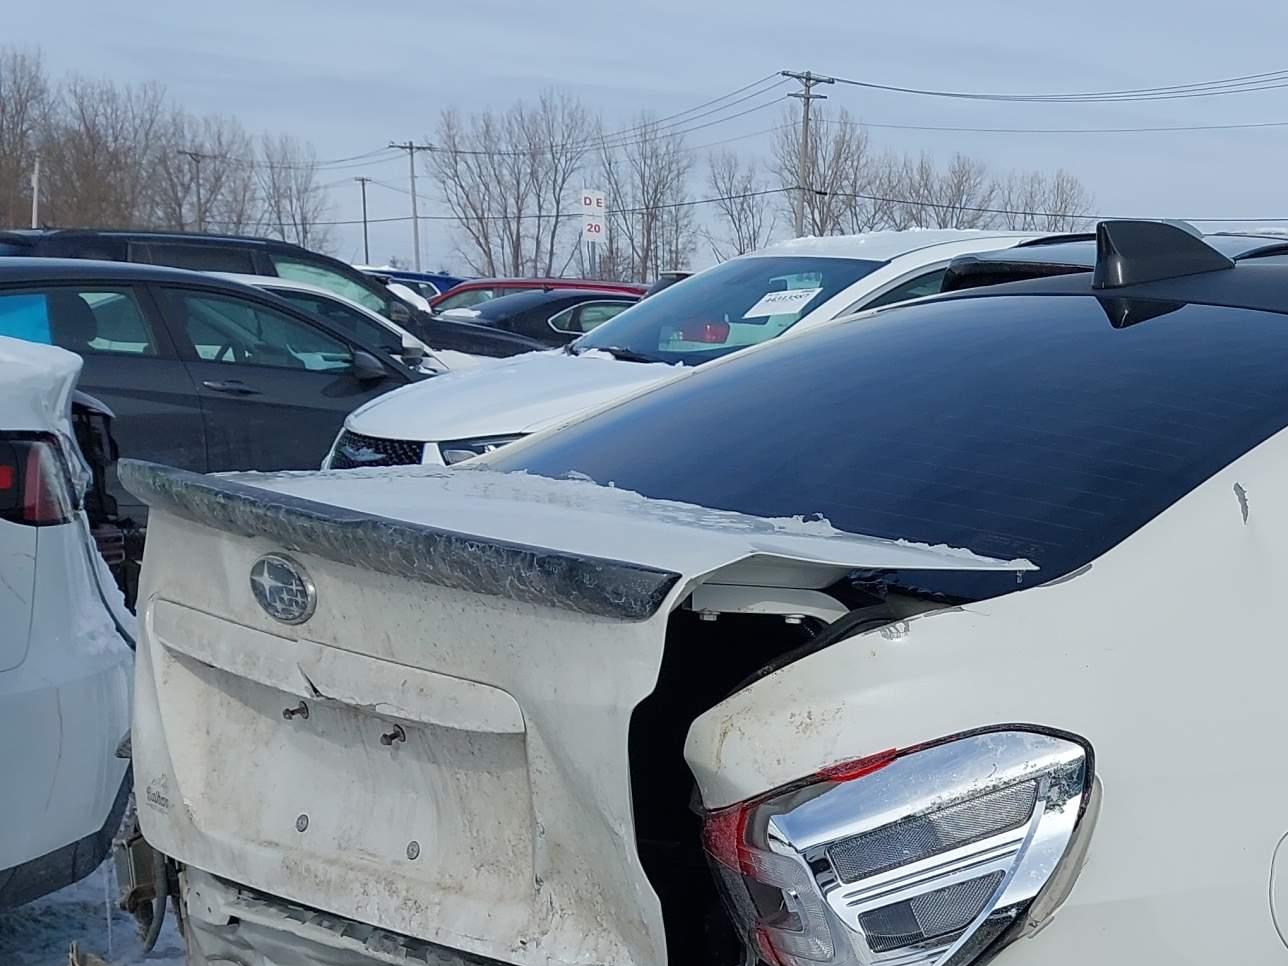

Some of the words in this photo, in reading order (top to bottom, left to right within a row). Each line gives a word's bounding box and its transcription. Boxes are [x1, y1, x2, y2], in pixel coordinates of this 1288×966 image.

[583, 196, 592, 206] D
[596, 198, 603, 208] E
[586, 223, 601, 234] 20
